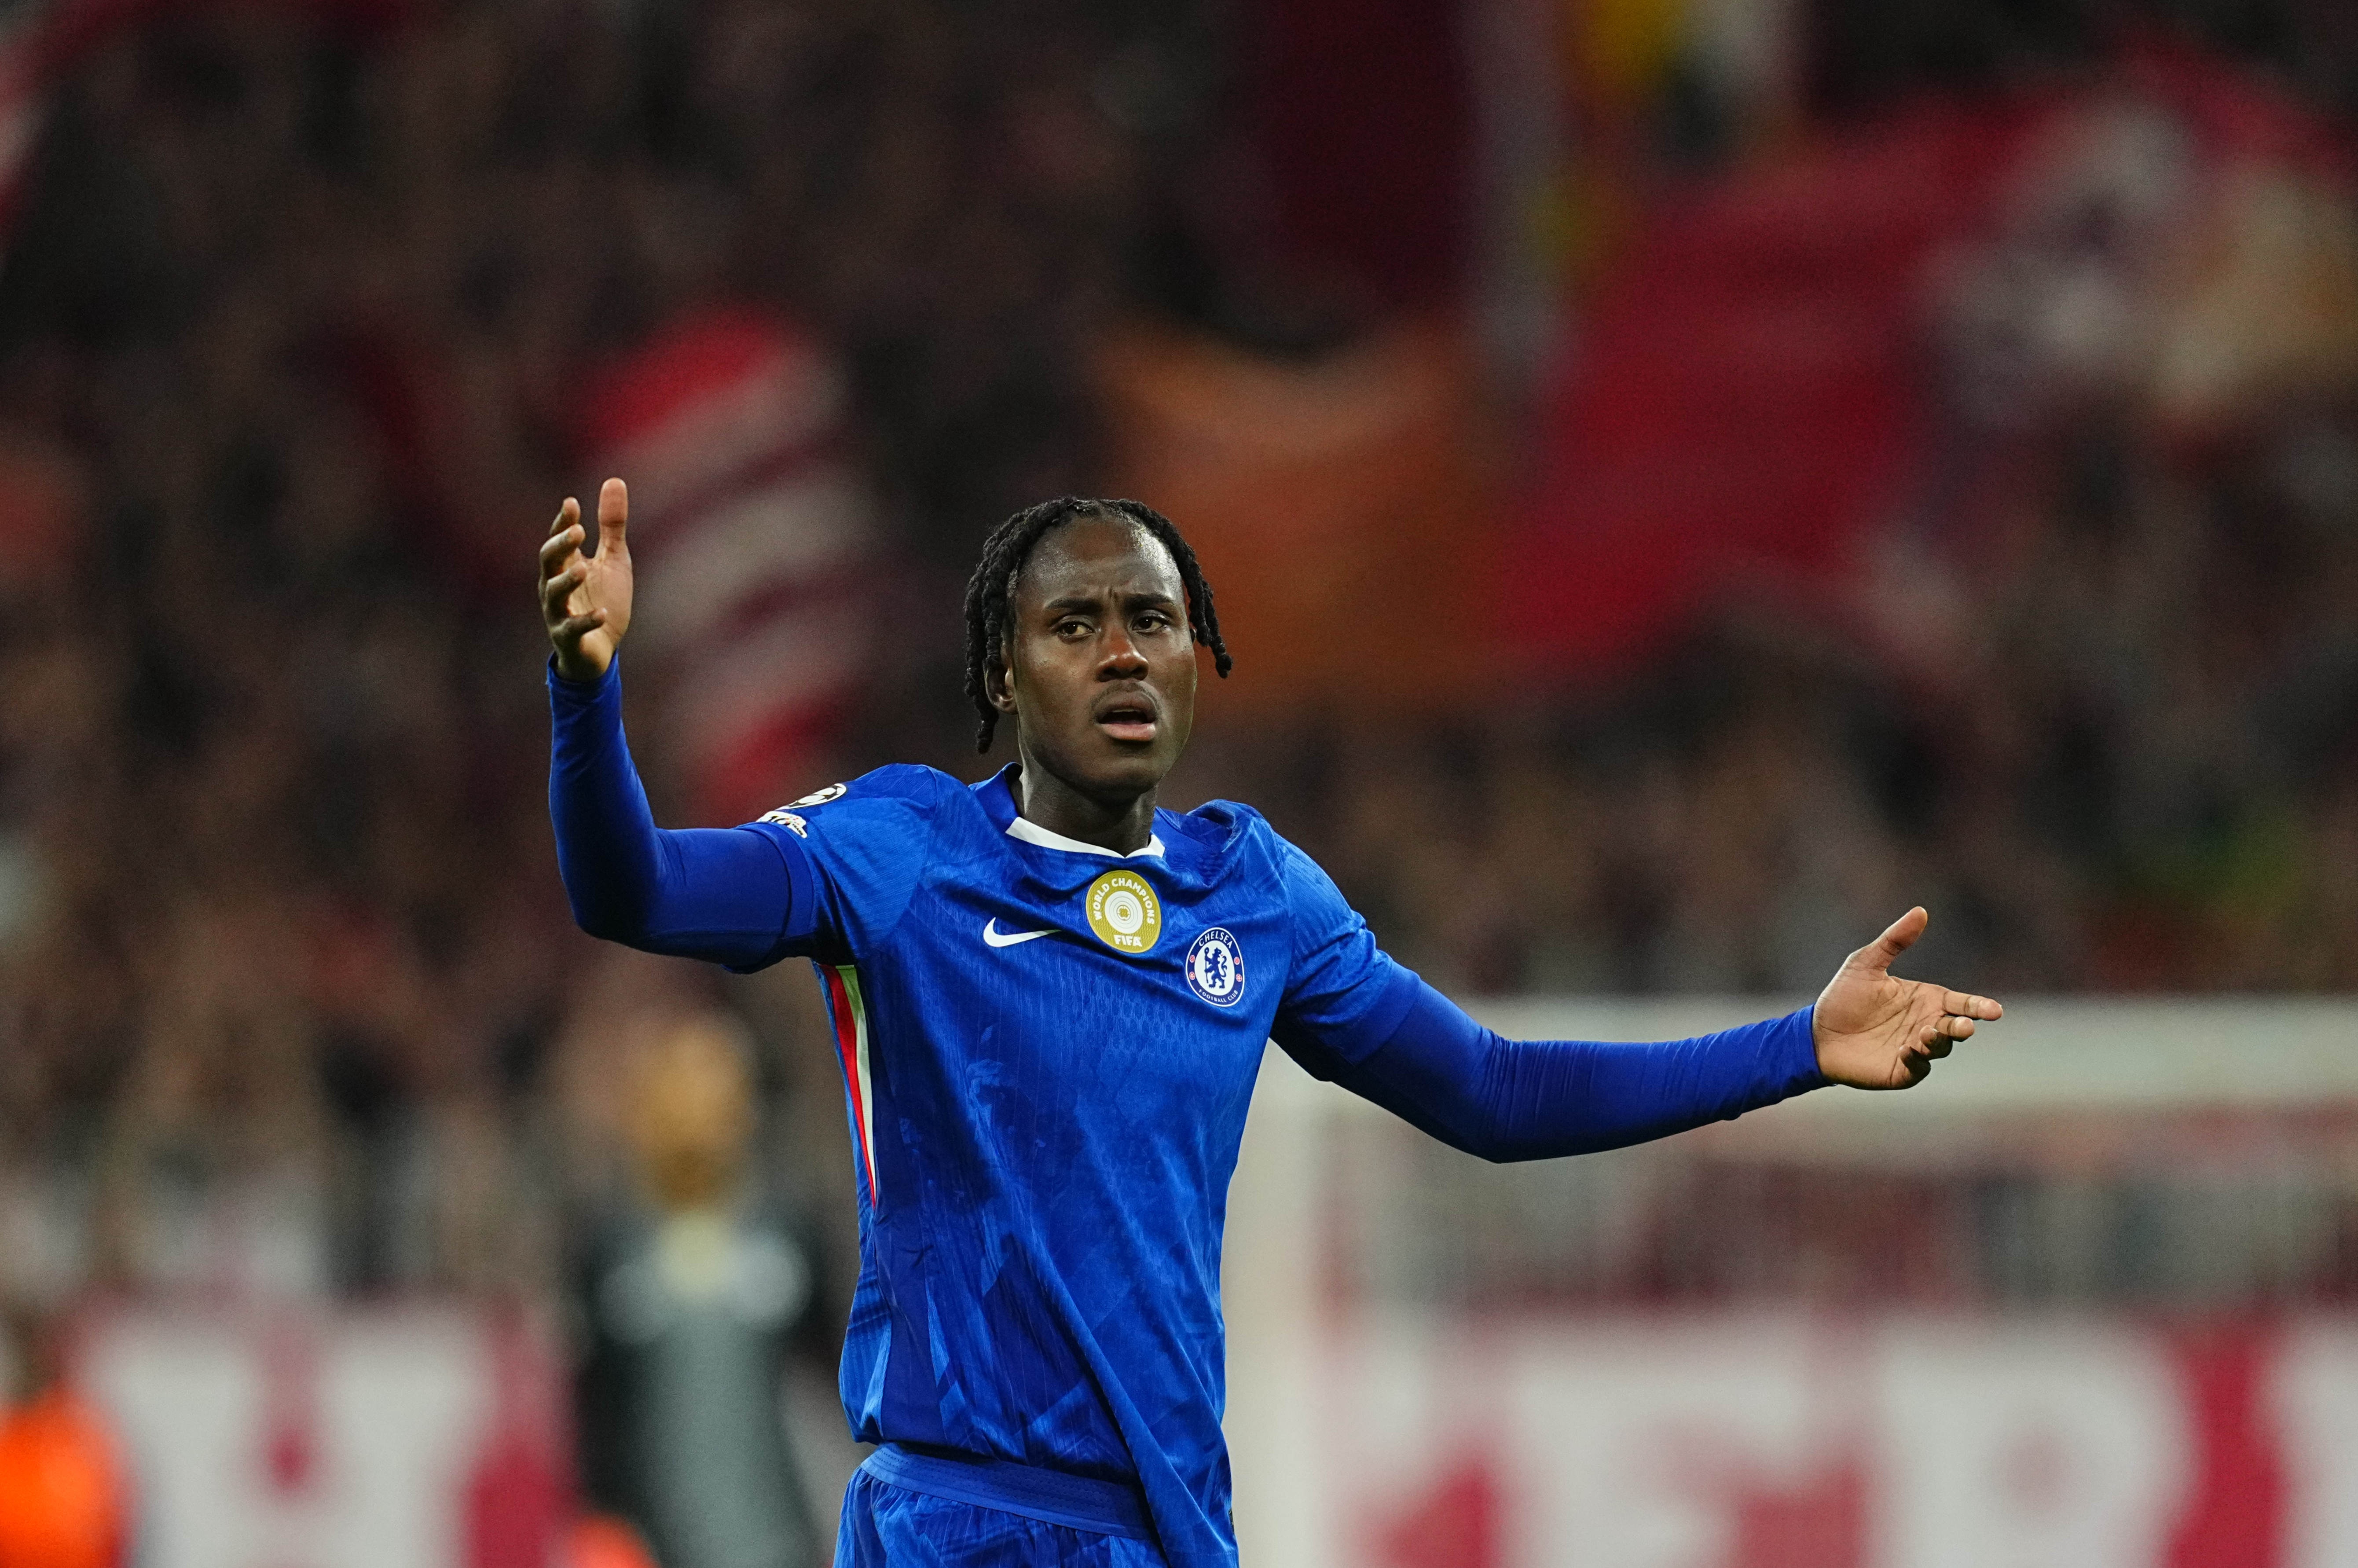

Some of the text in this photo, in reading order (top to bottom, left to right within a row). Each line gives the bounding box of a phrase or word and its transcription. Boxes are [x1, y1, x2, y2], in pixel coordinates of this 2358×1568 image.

[1093, 878, 1155, 924] WORLD CHAMPIONS
[1114, 934, 1142, 947] FIFA
[1199, 931, 1232, 949] CHELSEA
[1199, 989, 1238, 1003] FOOTBALL CLUB
